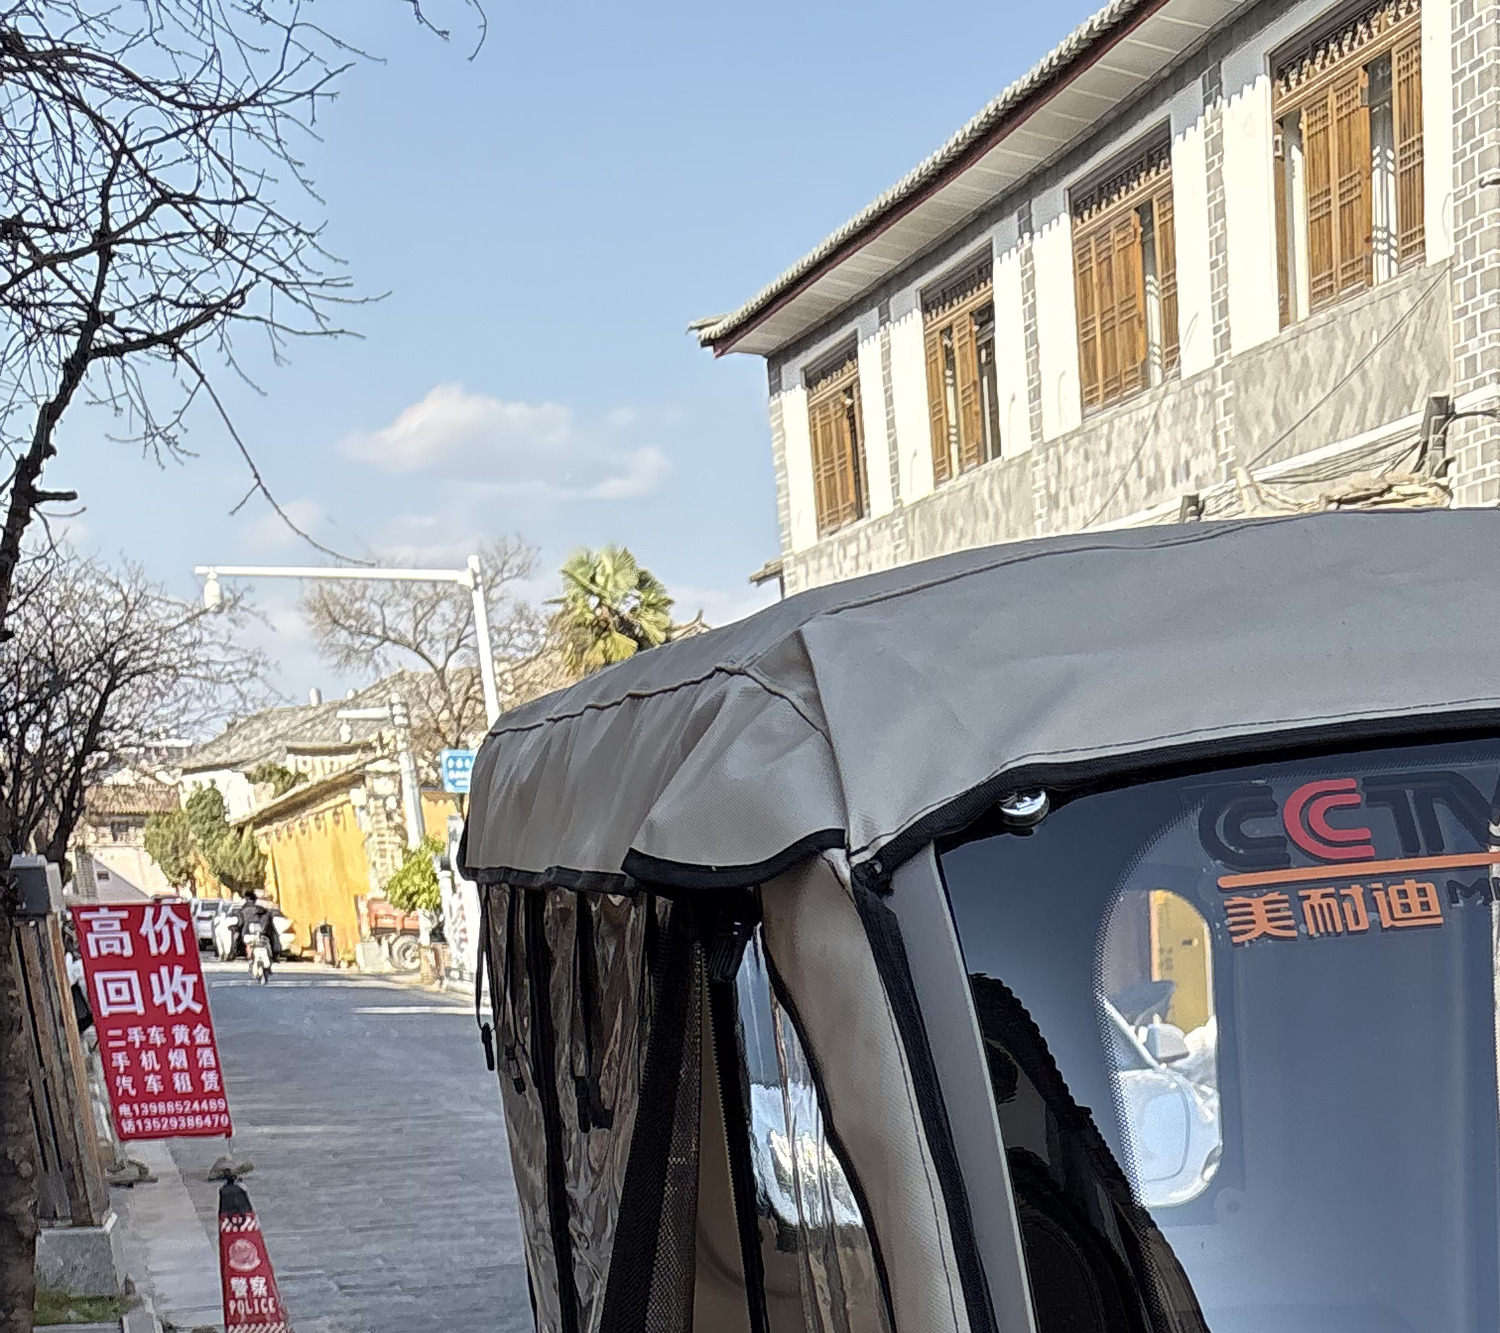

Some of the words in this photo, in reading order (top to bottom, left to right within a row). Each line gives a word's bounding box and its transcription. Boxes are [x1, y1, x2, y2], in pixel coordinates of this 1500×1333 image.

[1222, 878, 1444, 944] 美耐迪
[79, 906, 189, 958] 高价
[93, 965, 204, 1018] 回收
[106, 1025, 167, 1049] 二手车
[171, 1022, 212, 1047] 黄金
[229, 1297, 277, 1317] POLICE
[230, 1276, 269, 1299] 警察
